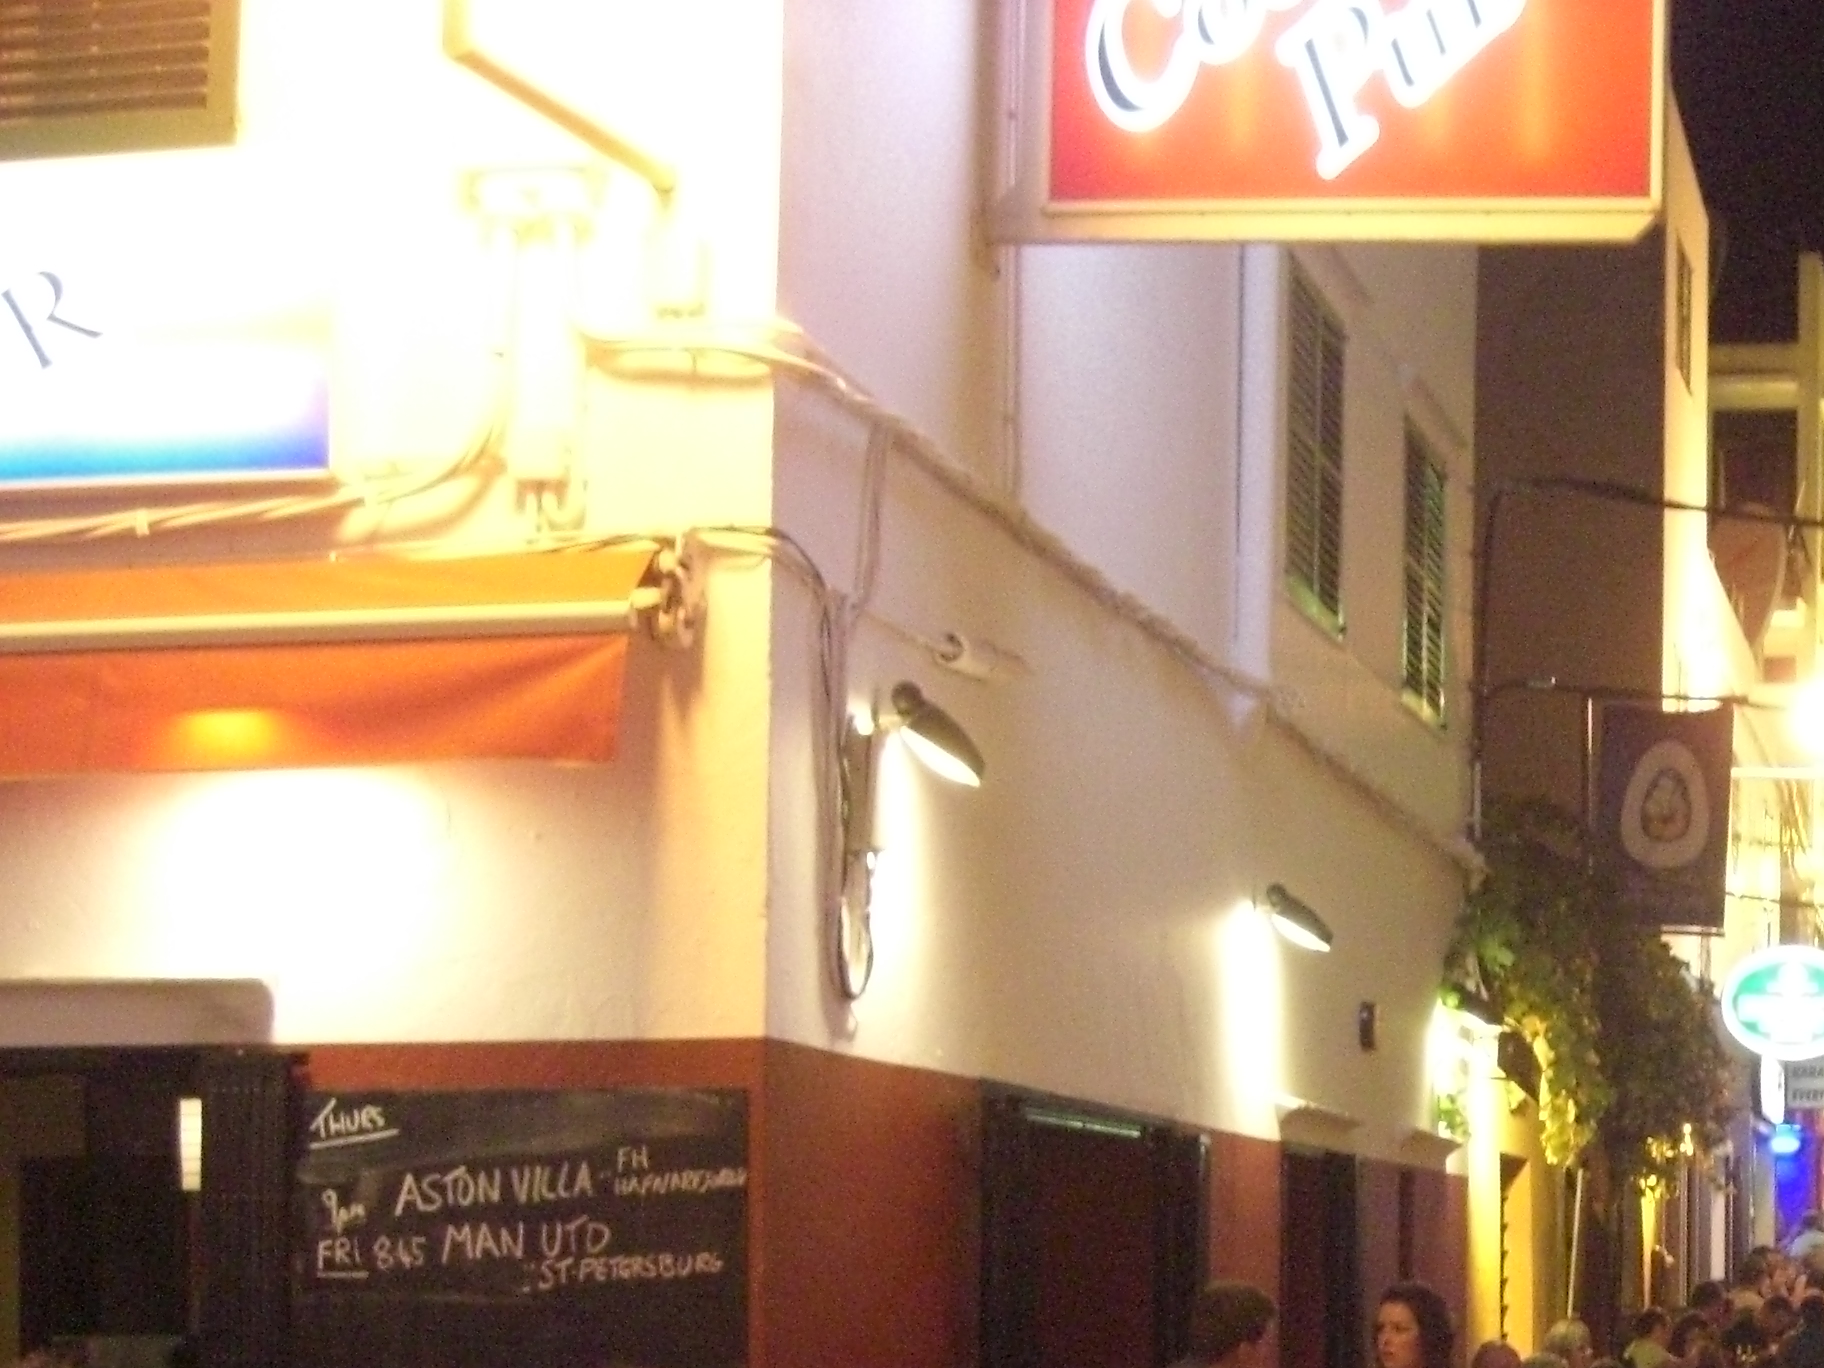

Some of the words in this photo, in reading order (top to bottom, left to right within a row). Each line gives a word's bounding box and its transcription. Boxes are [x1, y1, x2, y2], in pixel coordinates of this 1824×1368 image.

[617, 1144, 649, 1173] FH
[395, 1164, 502, 1217] ASTON
[510, 1160, 594, 1204] VILLA
[317, 1236, 362, 1271] FRI
[442, 1220, 525, 1265] MAN
[541, 1214, 612, 1258] UTD
